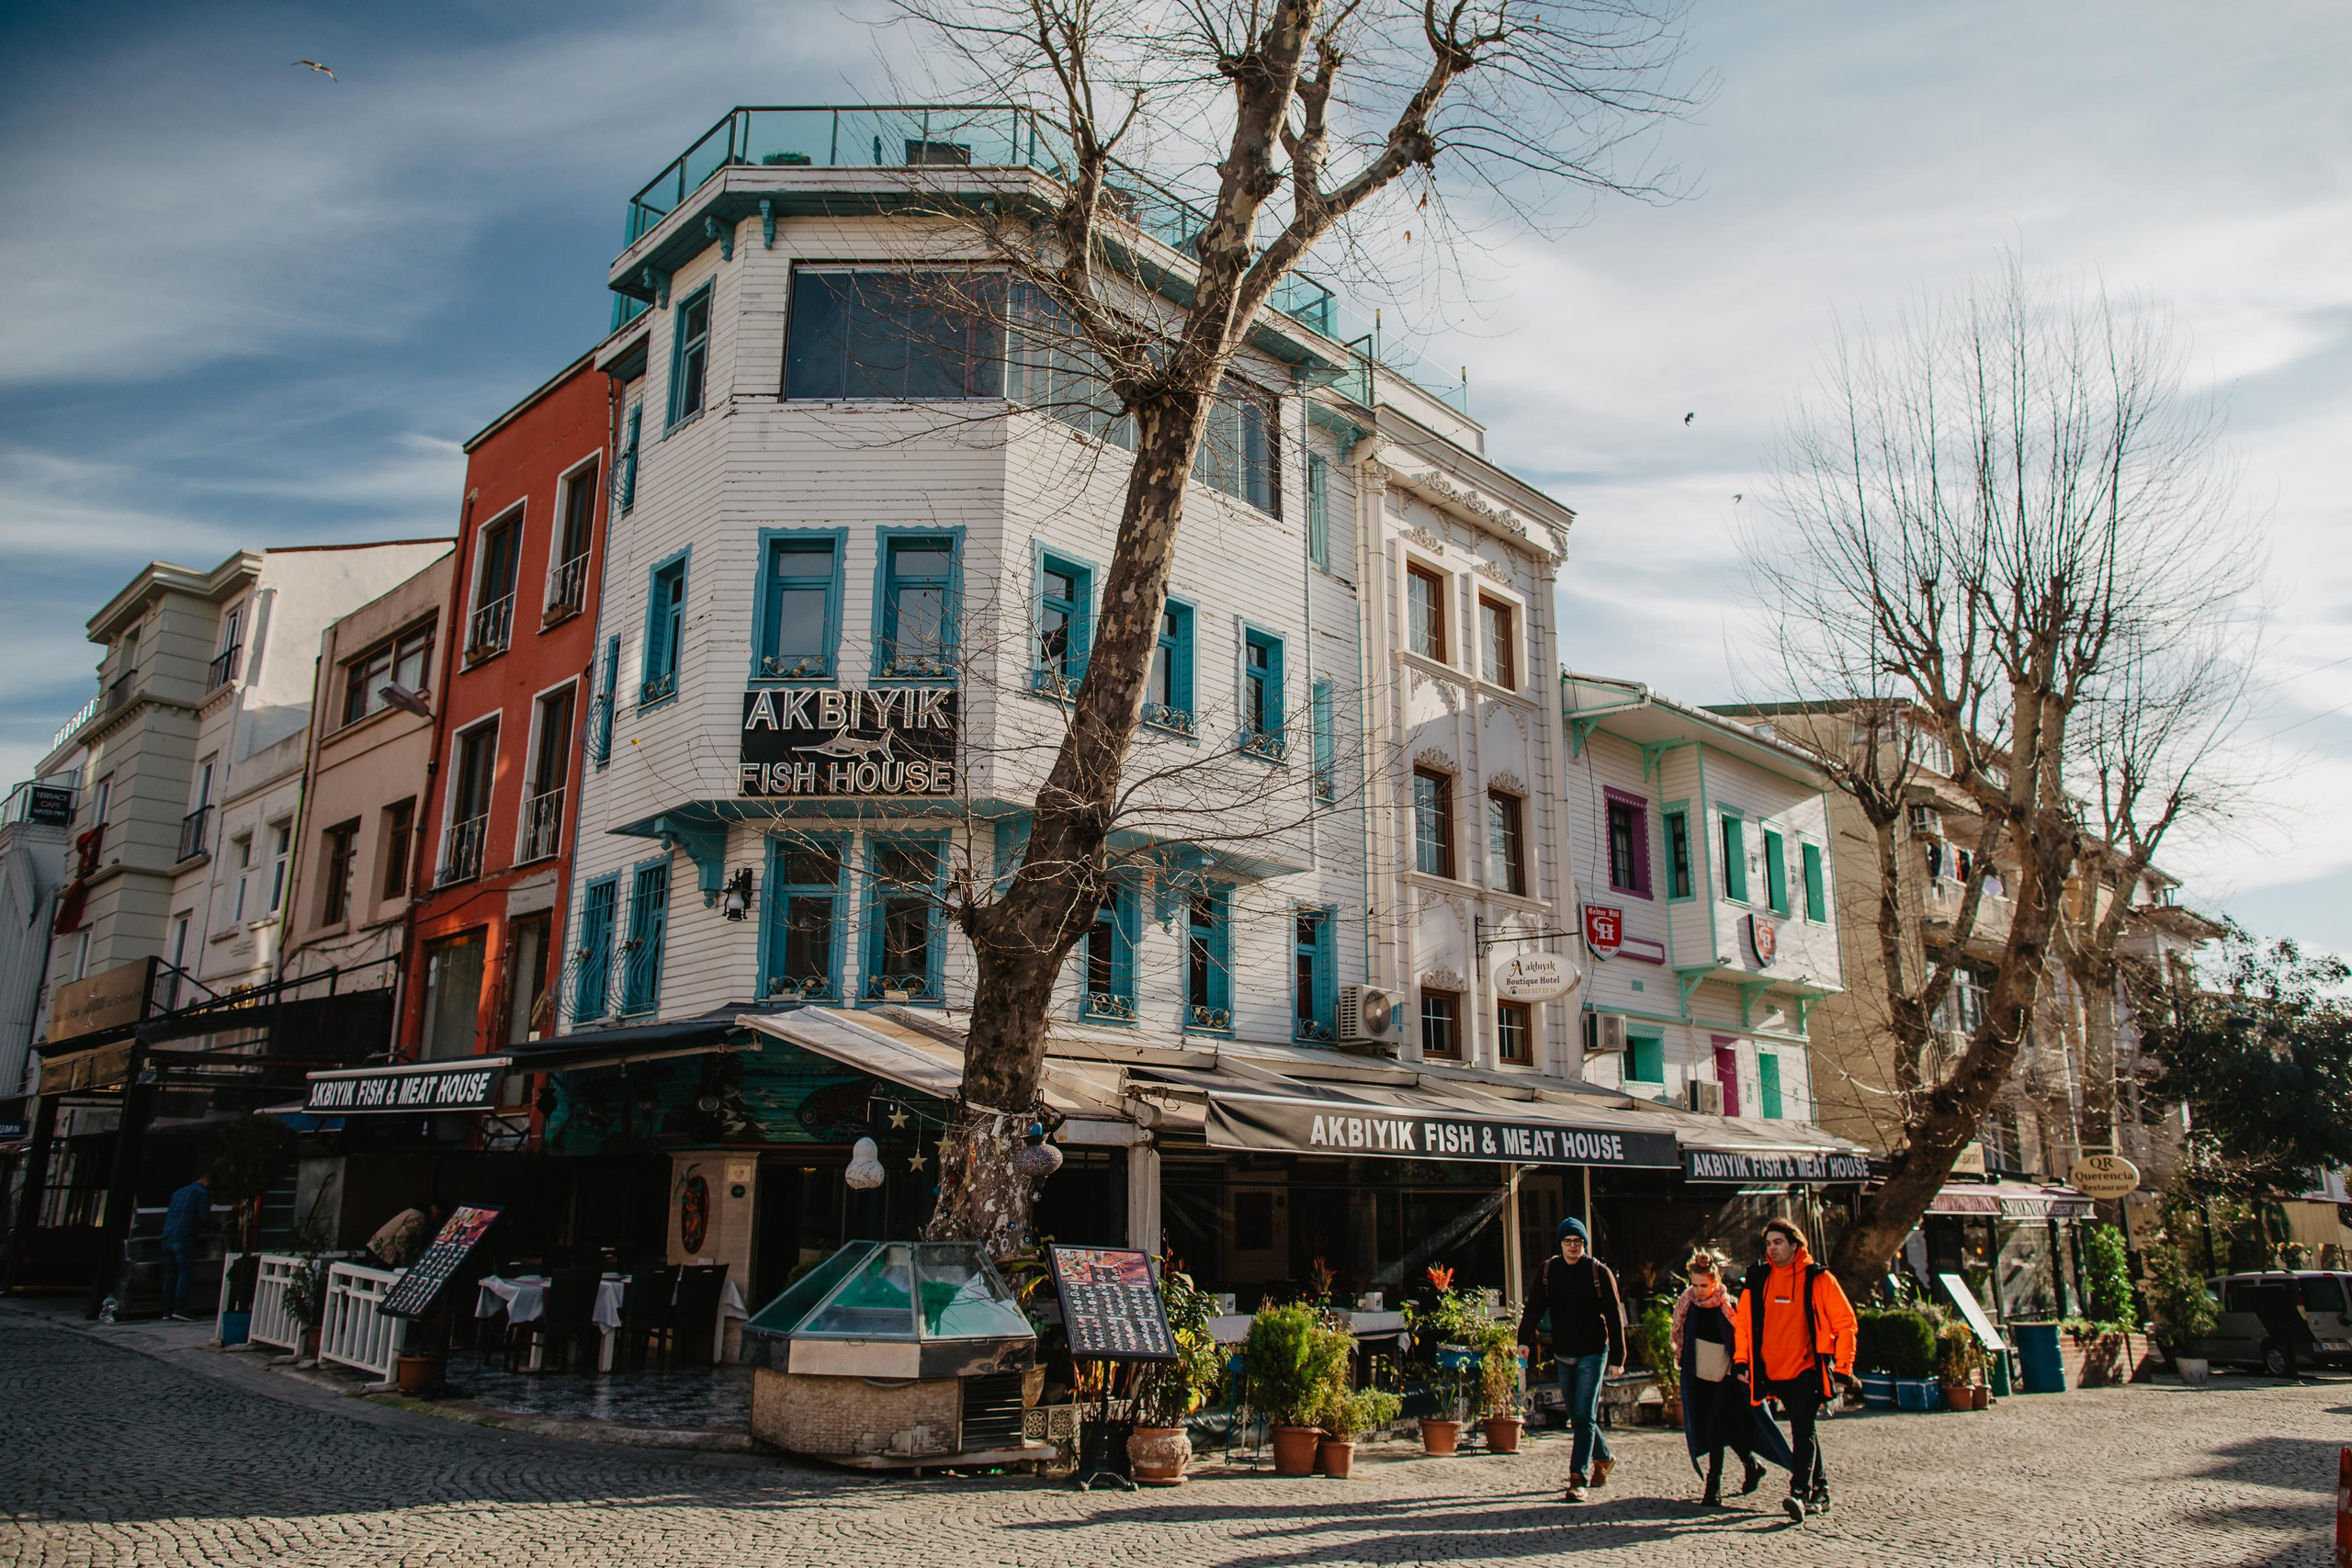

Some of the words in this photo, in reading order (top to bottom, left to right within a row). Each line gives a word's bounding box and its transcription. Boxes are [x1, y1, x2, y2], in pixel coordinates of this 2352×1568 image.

[744, 690, 953, 730] AKBIYIK
[737, 762, 816, 795] FISH
[829, 761, 953, 794] HOUSE
[37, 792, 68, 801] TERRACE
[1506, 977, 1539, 987] Boutique
[1540, 976, 1560, 985] Hotel
[309, 1081, 356, 1107] AKBIYIK
[356, 1078, 388, 1106] FISH
[385, 1078, 398, 1105] &
[397, 1076, 438, 1105] MEAT
[435, 1072, 492, 1103] HOUSE
[1309, 1114, 1416, 1151] AKBIYIK
[1424, 1122, 1475, 1154] FISH
[1482, 1126, 1498, 1155] &
[1502, 1127, 1555, 1157] MEAT
[1561, 1132, 1624, 1161] HOUSE
[1693, 1153, 1750, 1178] AKBIYIK
[1752, 1155, 1783, 1178] FISH
[1785, 1156, 1795, 1178] &
[1797, 1156, 1827, 1178] MEAT
[1829, 1156, 1871, 1178] HOUSE
[2089, 1156, 2114, 1171] QR
[2075, 1171, 2134, 1182] Querencia
[2082, 1183, 2130, 1191] Restaurant
